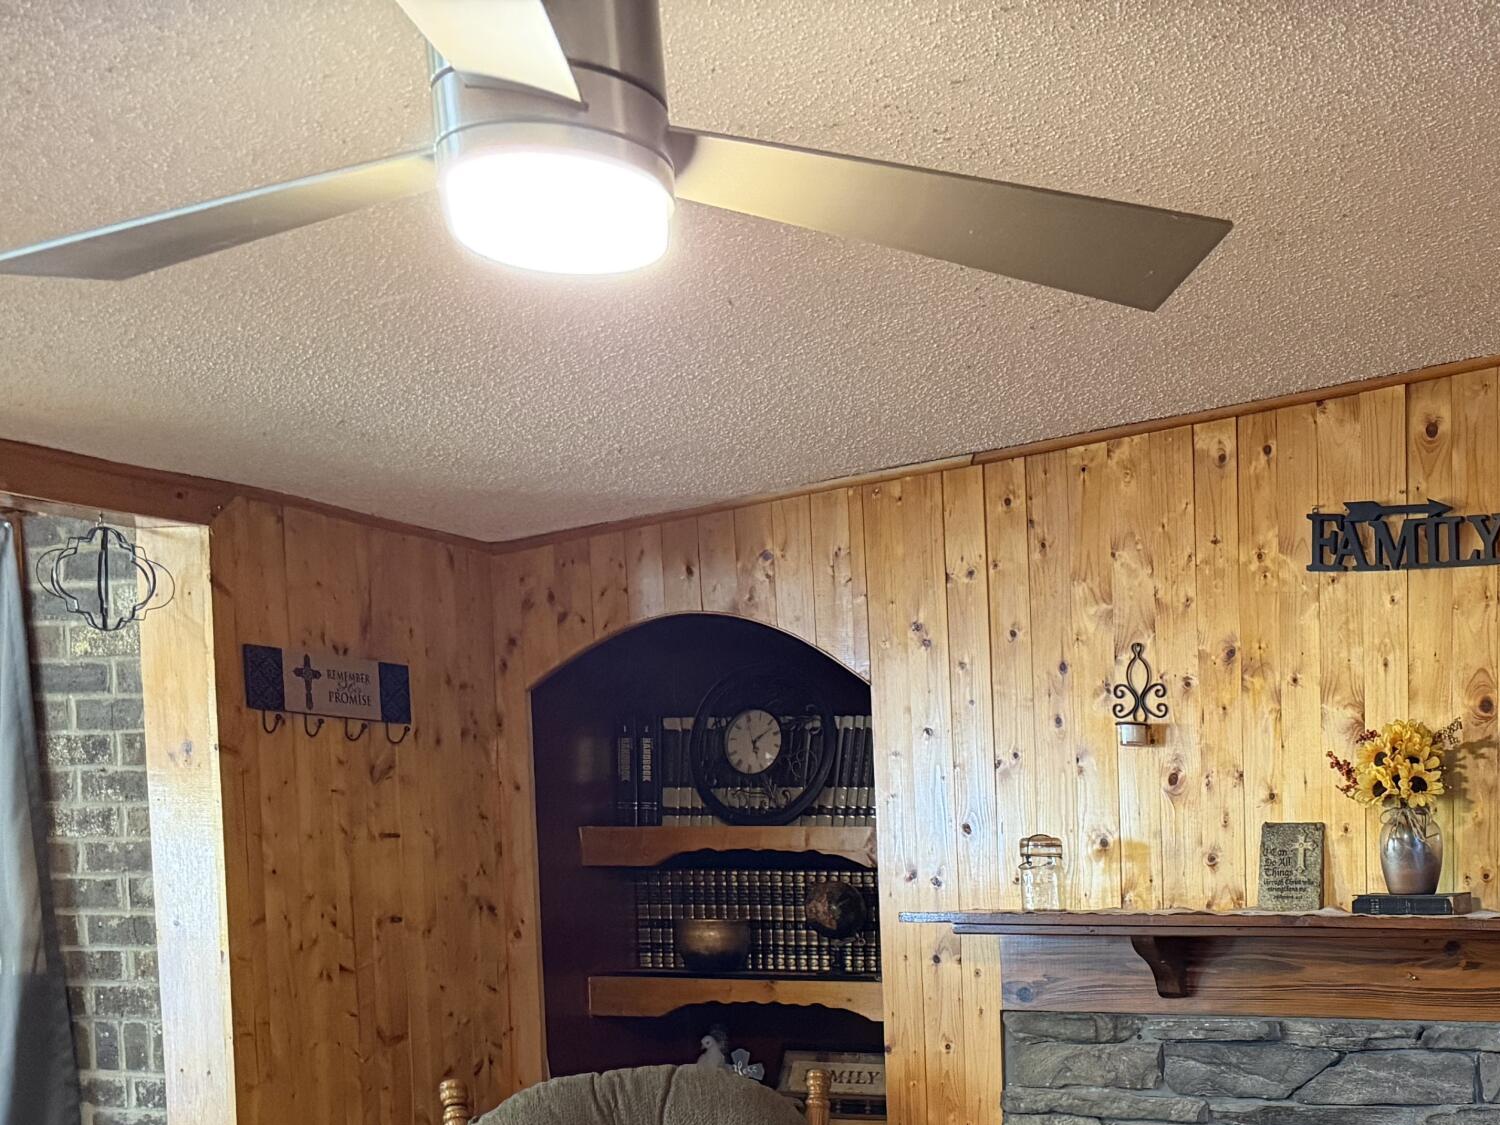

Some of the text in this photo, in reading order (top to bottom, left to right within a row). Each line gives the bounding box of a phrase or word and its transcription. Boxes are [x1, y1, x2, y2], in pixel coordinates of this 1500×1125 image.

[327, 669, 370, 685] REMEMBER
[329, 691, 371, 706] PROMISE
[1264, 867, 1294, 878] Things
